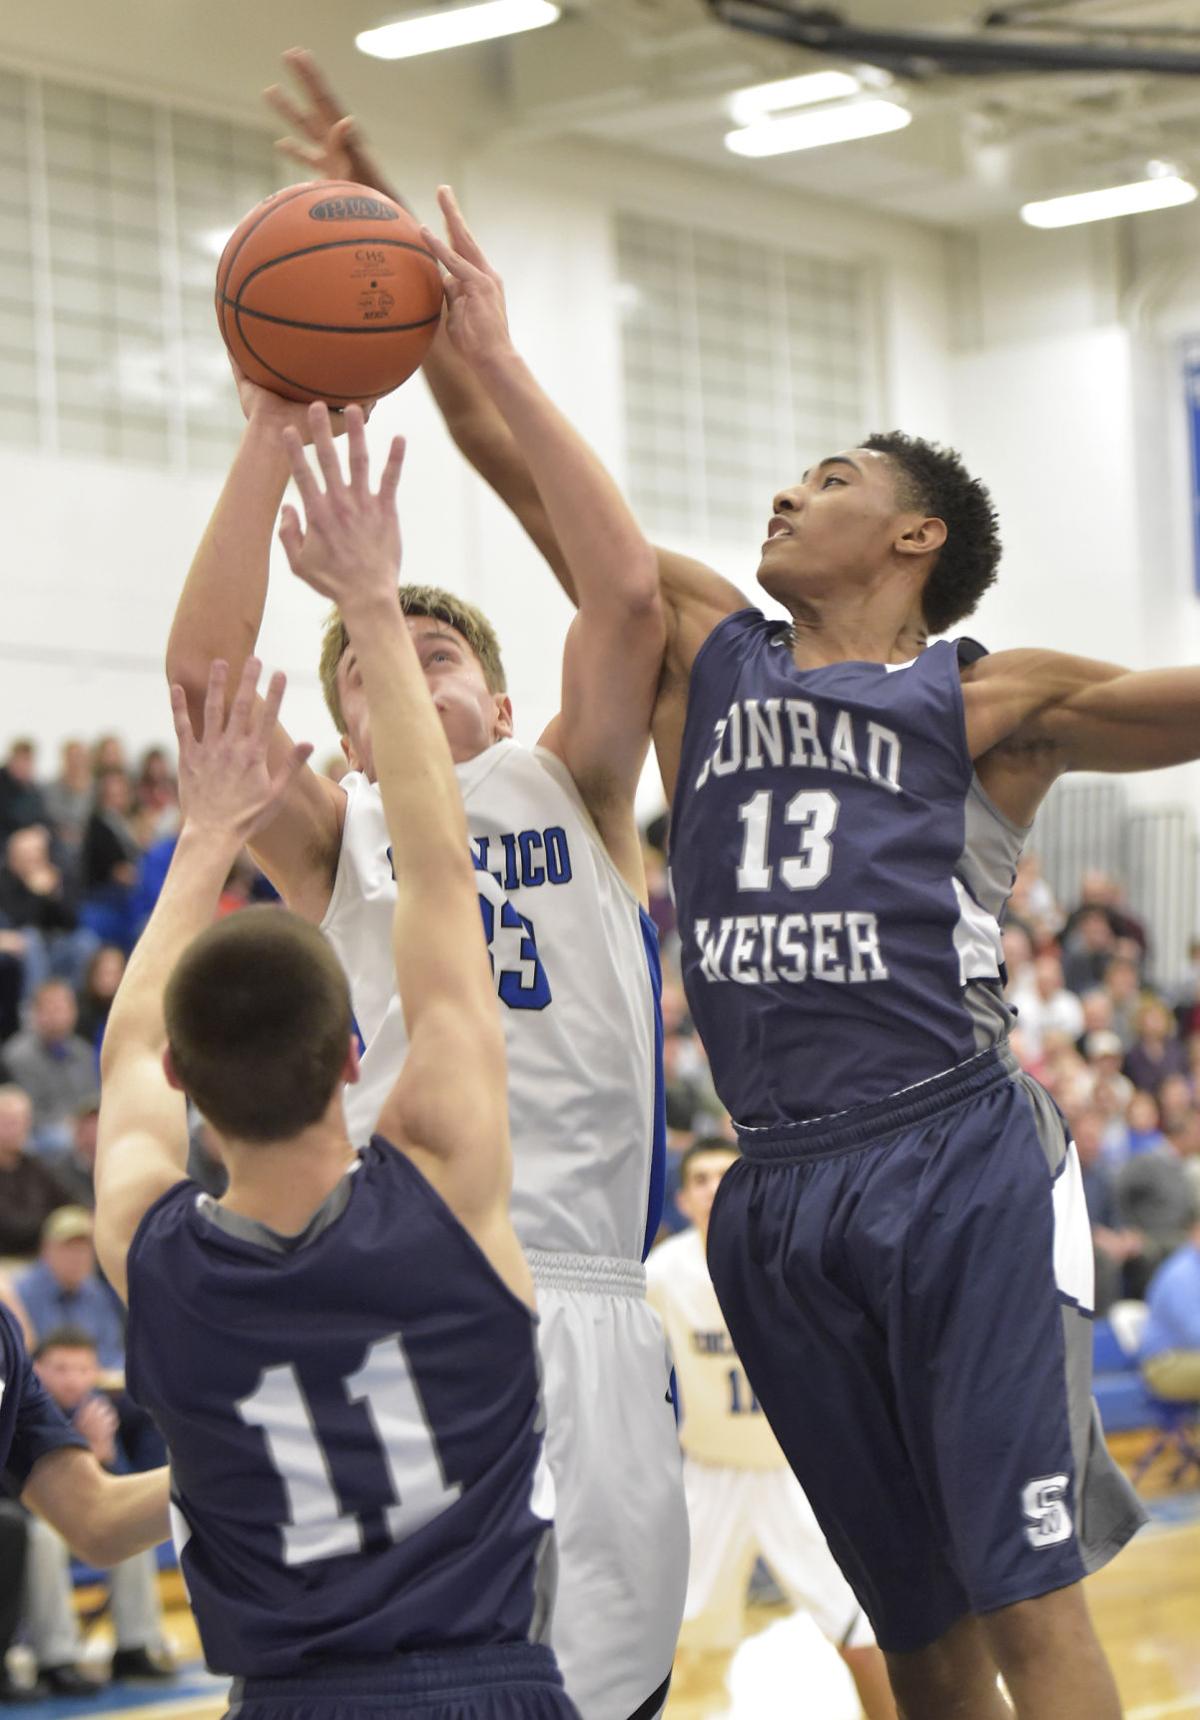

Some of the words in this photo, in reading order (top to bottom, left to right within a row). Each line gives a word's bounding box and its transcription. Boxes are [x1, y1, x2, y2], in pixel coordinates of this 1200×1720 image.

[354, 249, 386, 264] CHS
[735, 788, 841, 892] 13
[694, 911, 889, 985] WEISER
[233, 1331, 464, 1568] 11
